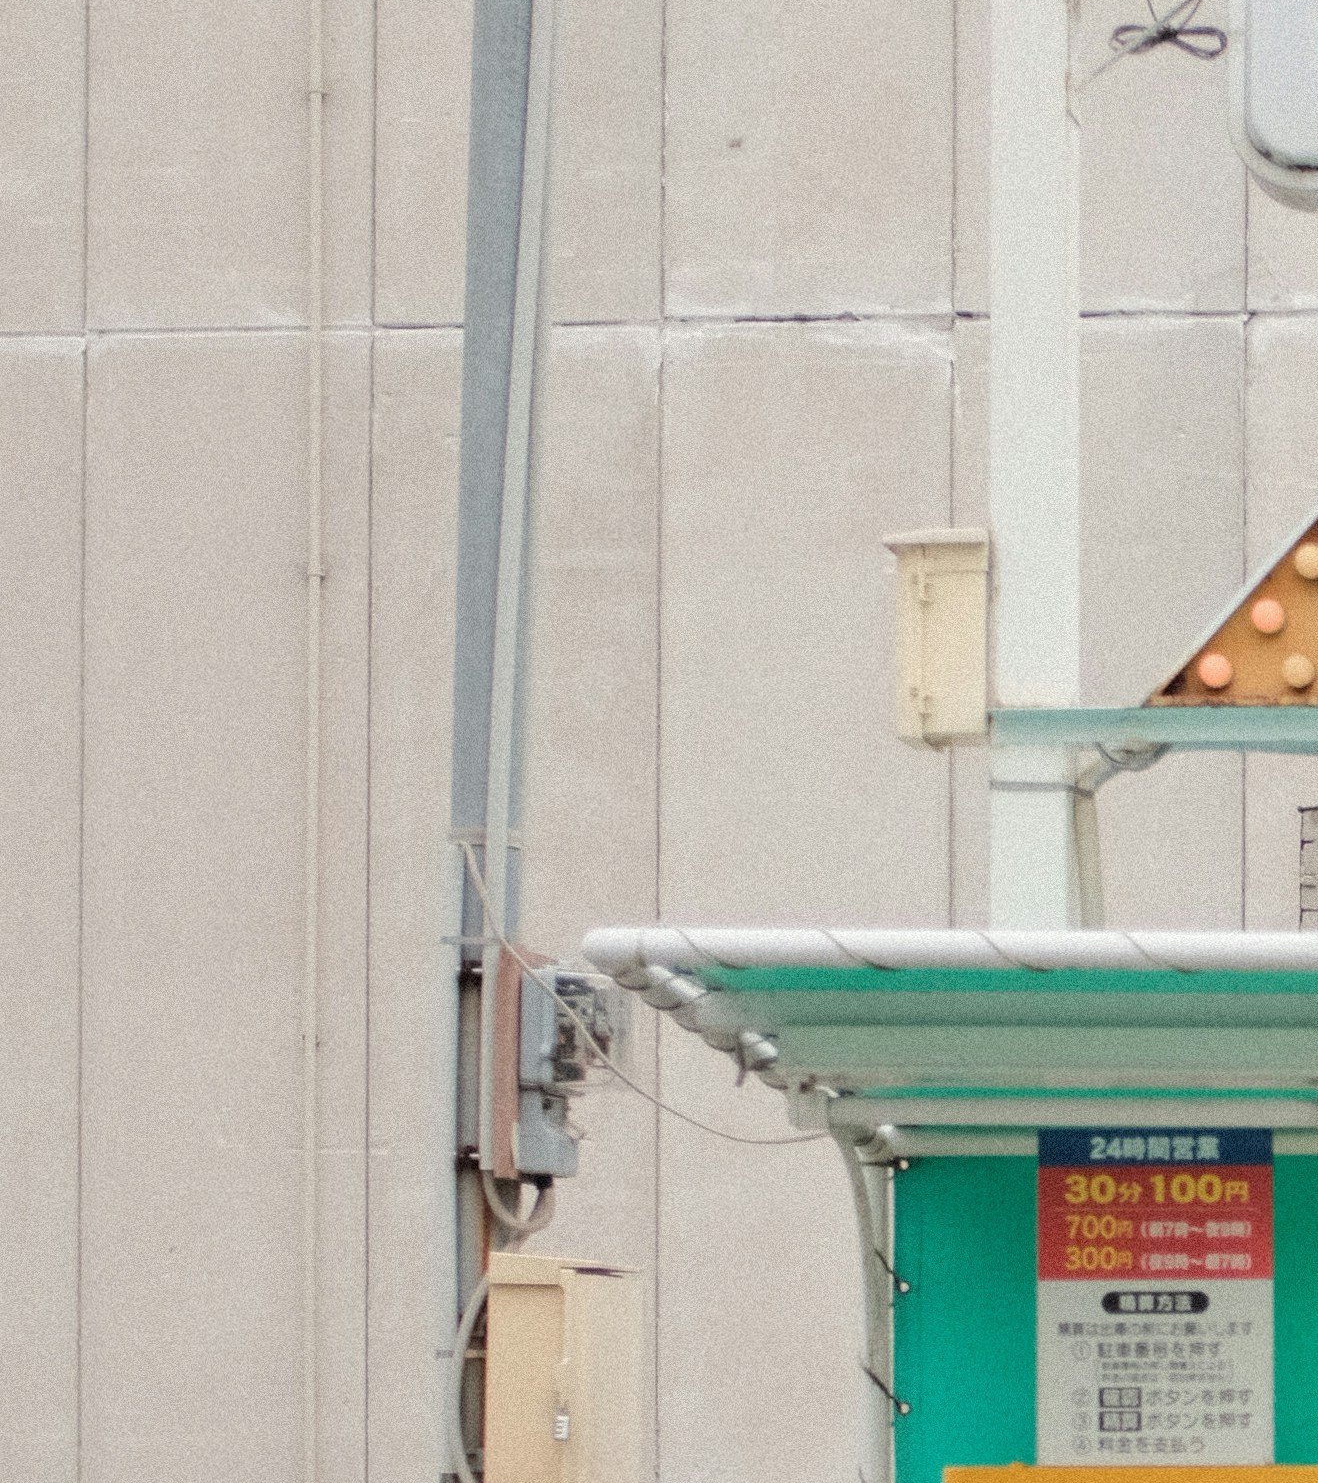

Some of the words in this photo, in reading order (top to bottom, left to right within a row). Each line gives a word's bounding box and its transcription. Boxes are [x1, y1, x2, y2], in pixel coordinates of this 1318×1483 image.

[1090, 1136, 1219, 1160] 24時間営業
[1065, 1174, 1142, 1204] 30分
[1150, 1174, 1249, 1204] 100円
[1065, 1215, 1134, 1239] 700円
[1065, 1246, 1134, 1270] 300円
